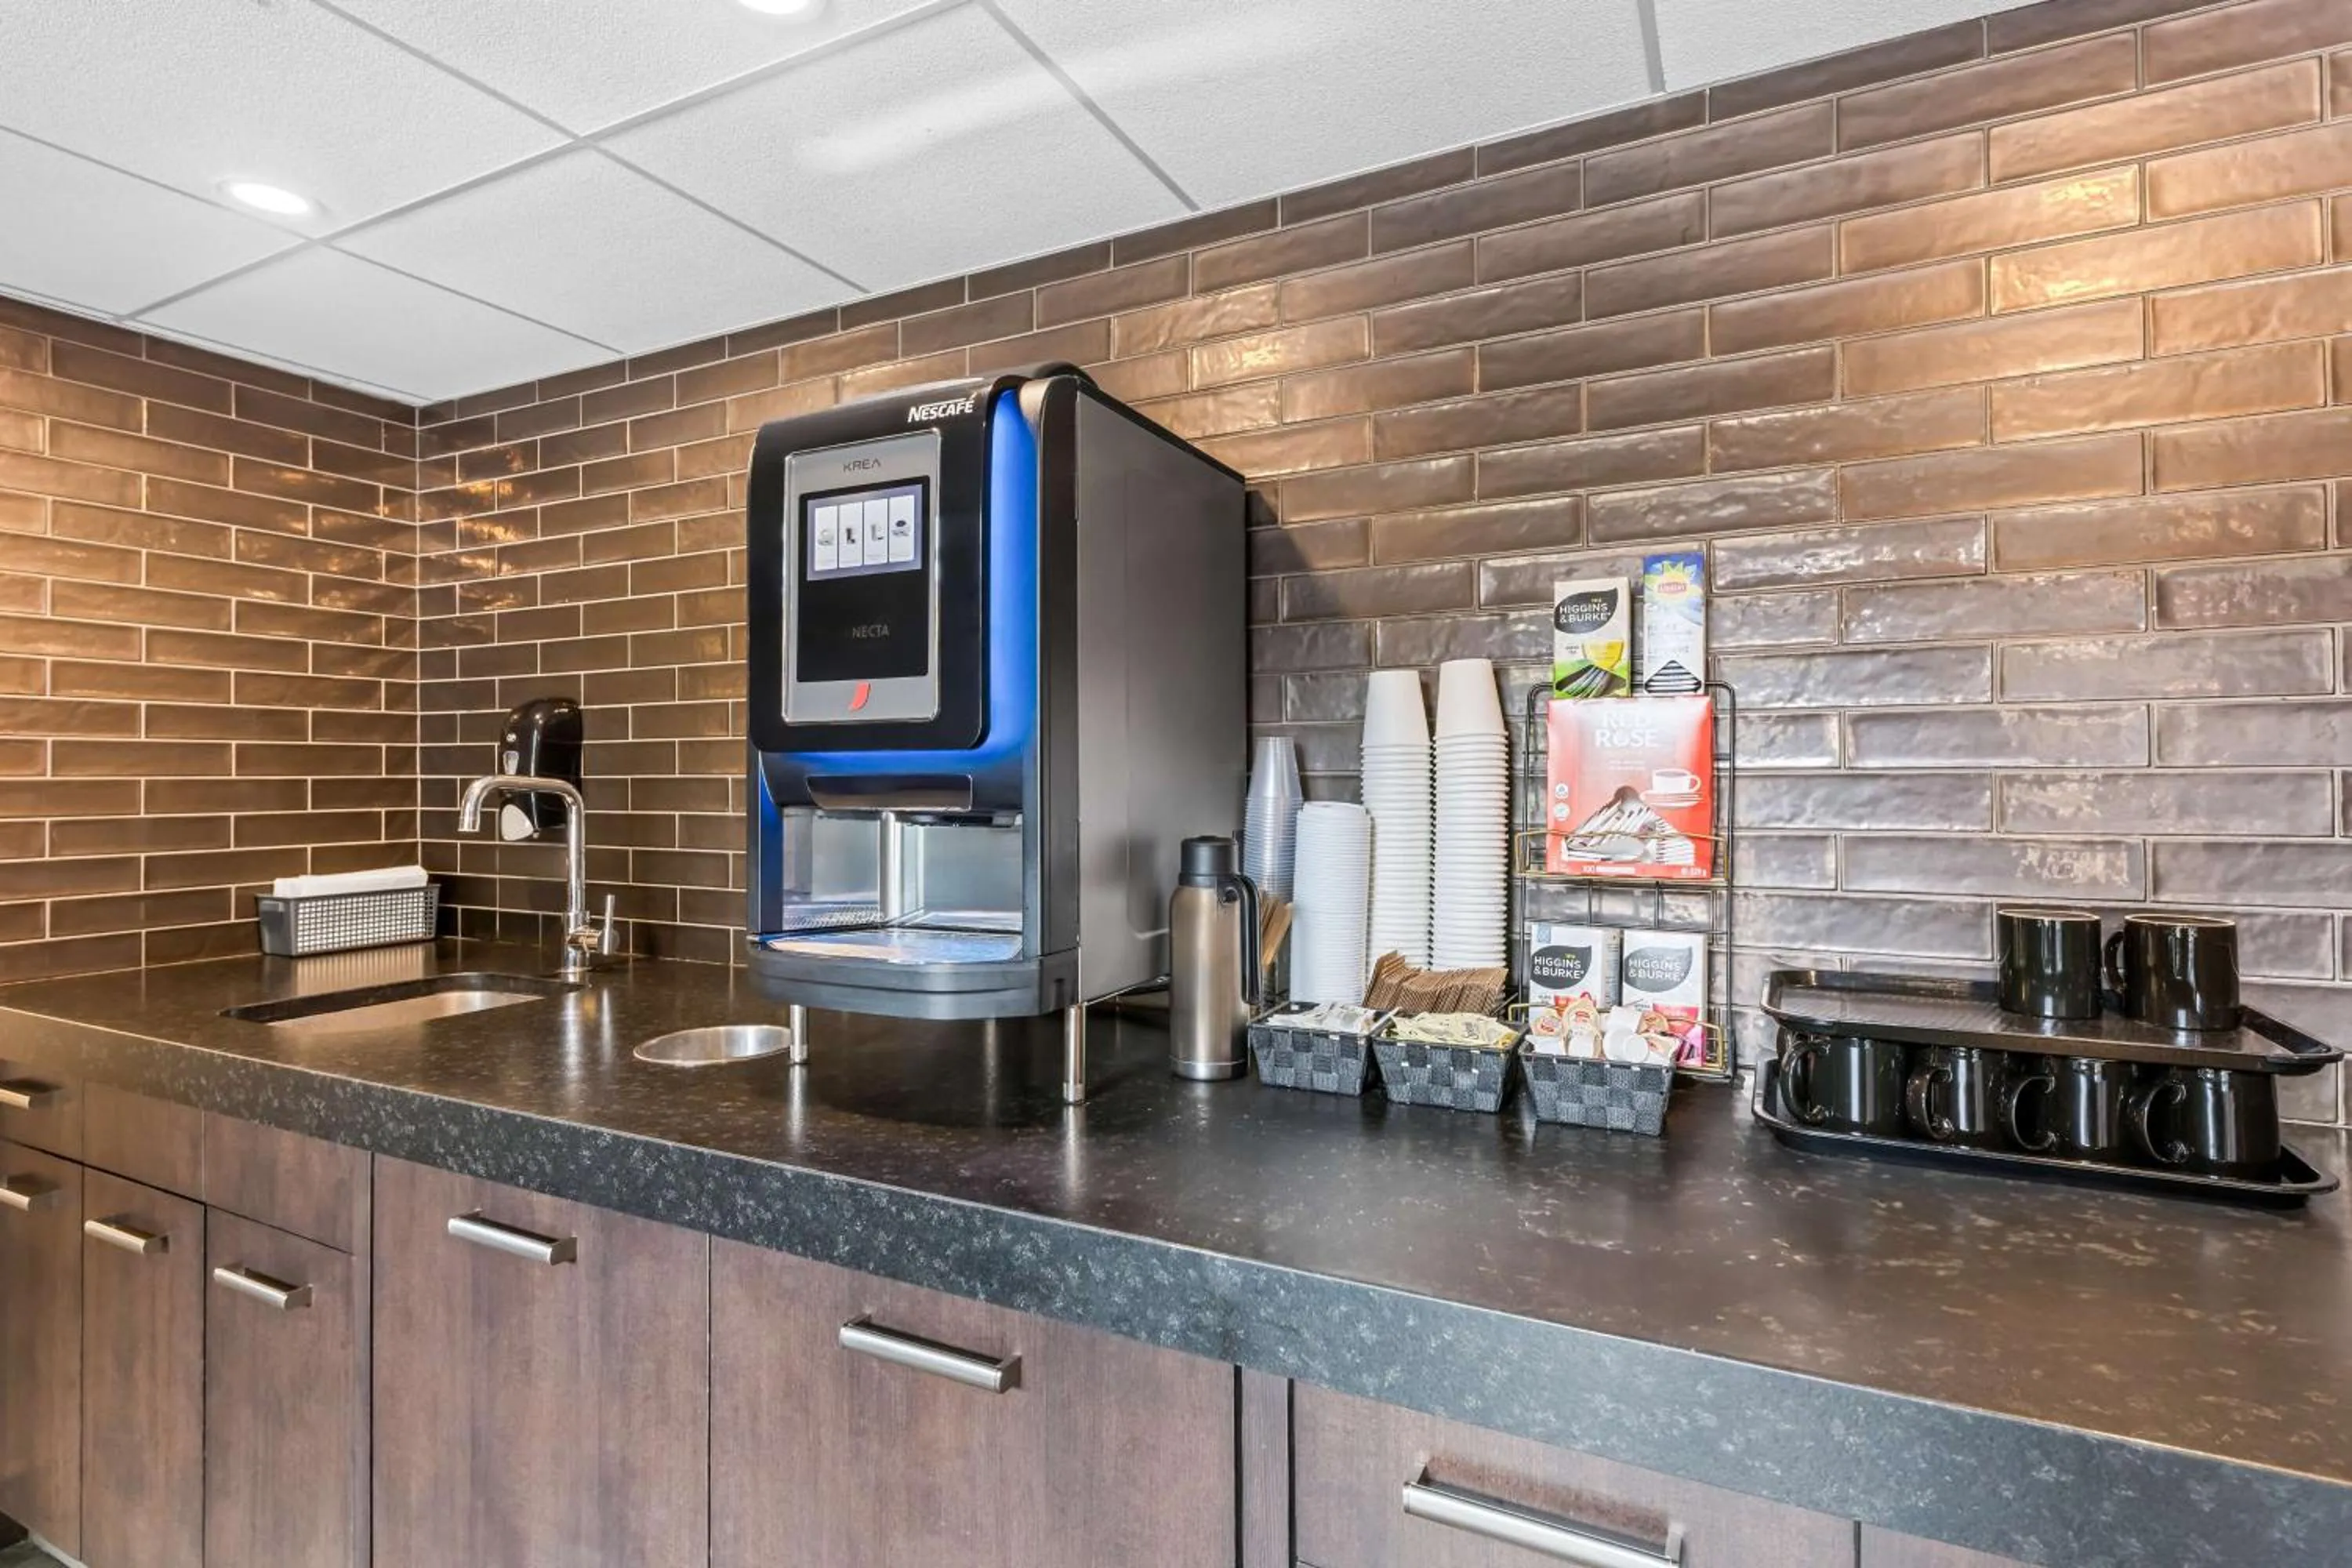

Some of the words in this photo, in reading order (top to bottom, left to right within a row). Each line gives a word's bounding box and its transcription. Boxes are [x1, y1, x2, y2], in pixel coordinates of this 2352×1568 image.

[843, 459, 881, 472] KREA
[1559, 603, 1609, 614] HIGGINS
[852, 624, 890, 638] NECTA
[1595, 728, 1659, 748] ROSE
[1534, 956, 1581, 970] HIGGINS
[1628, 958, 1682, 974] HIGGINS
